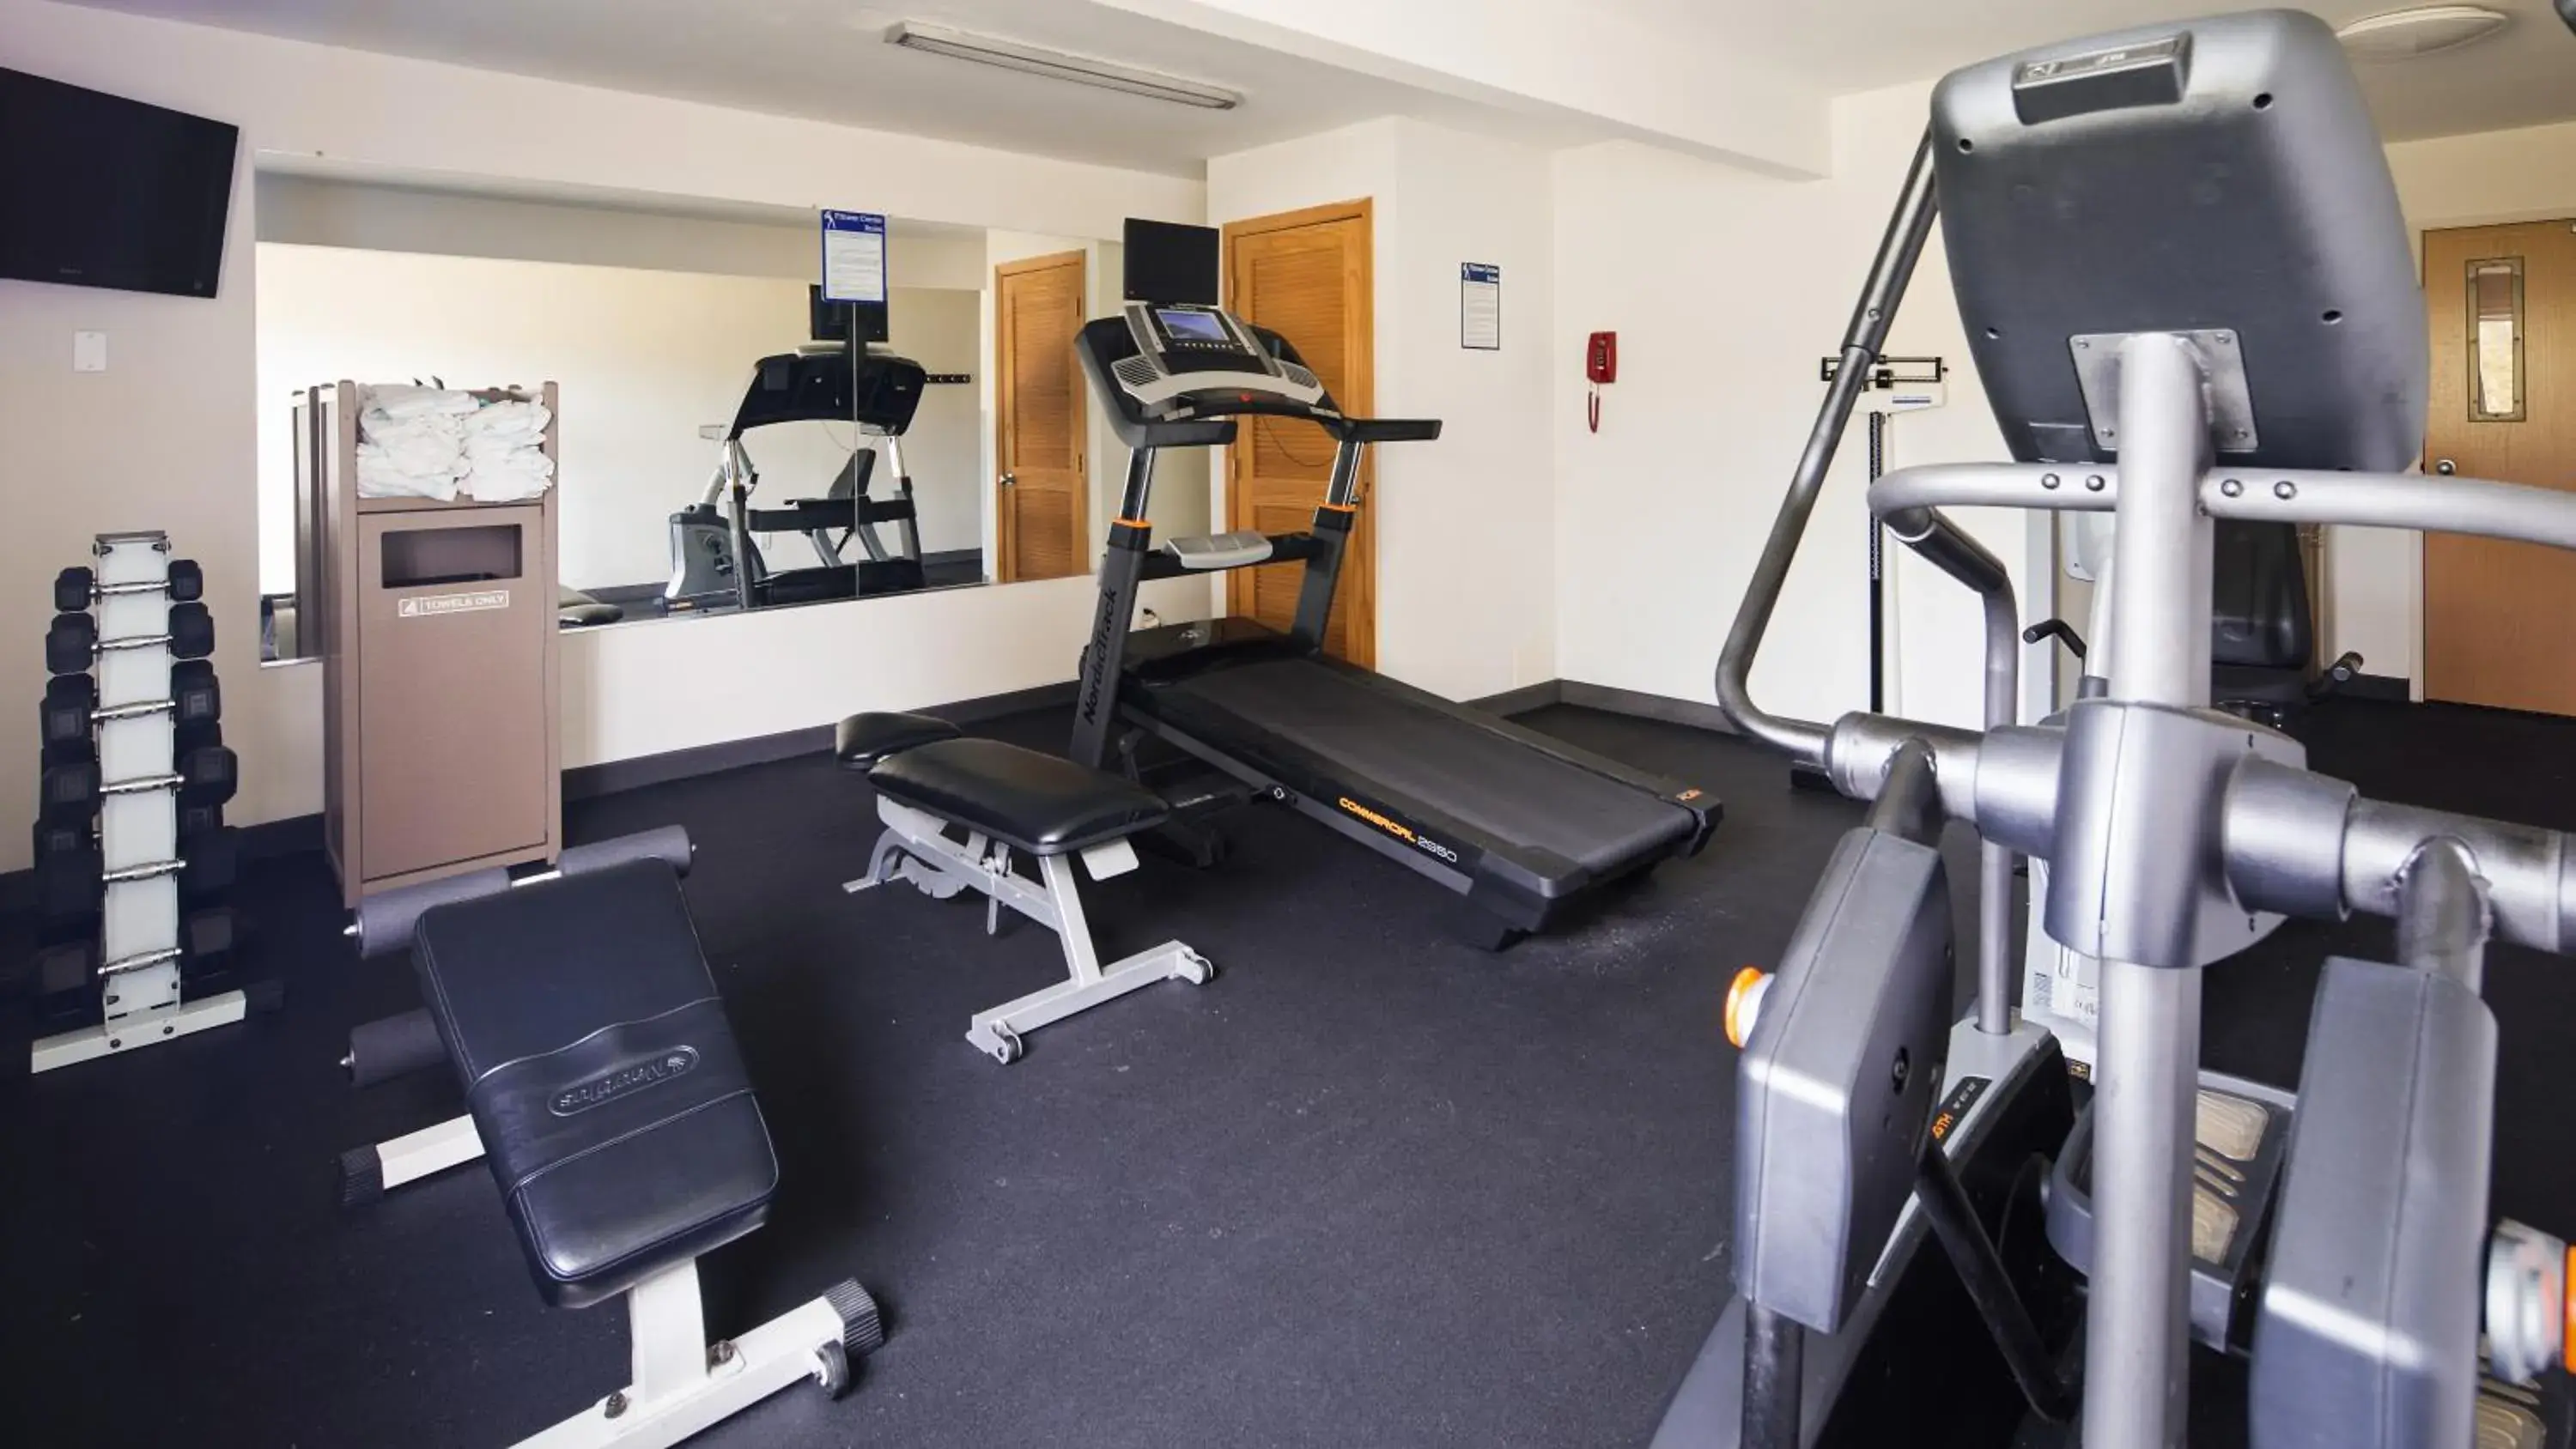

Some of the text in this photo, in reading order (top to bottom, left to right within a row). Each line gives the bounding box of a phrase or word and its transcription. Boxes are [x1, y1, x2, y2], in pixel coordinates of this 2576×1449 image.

[424, 594, 506, 611] TOWELS ONLY
[1084, 587, 1117, 726] NordicTrack
[1339, 797, 1417, 843] COMMERCIAL
